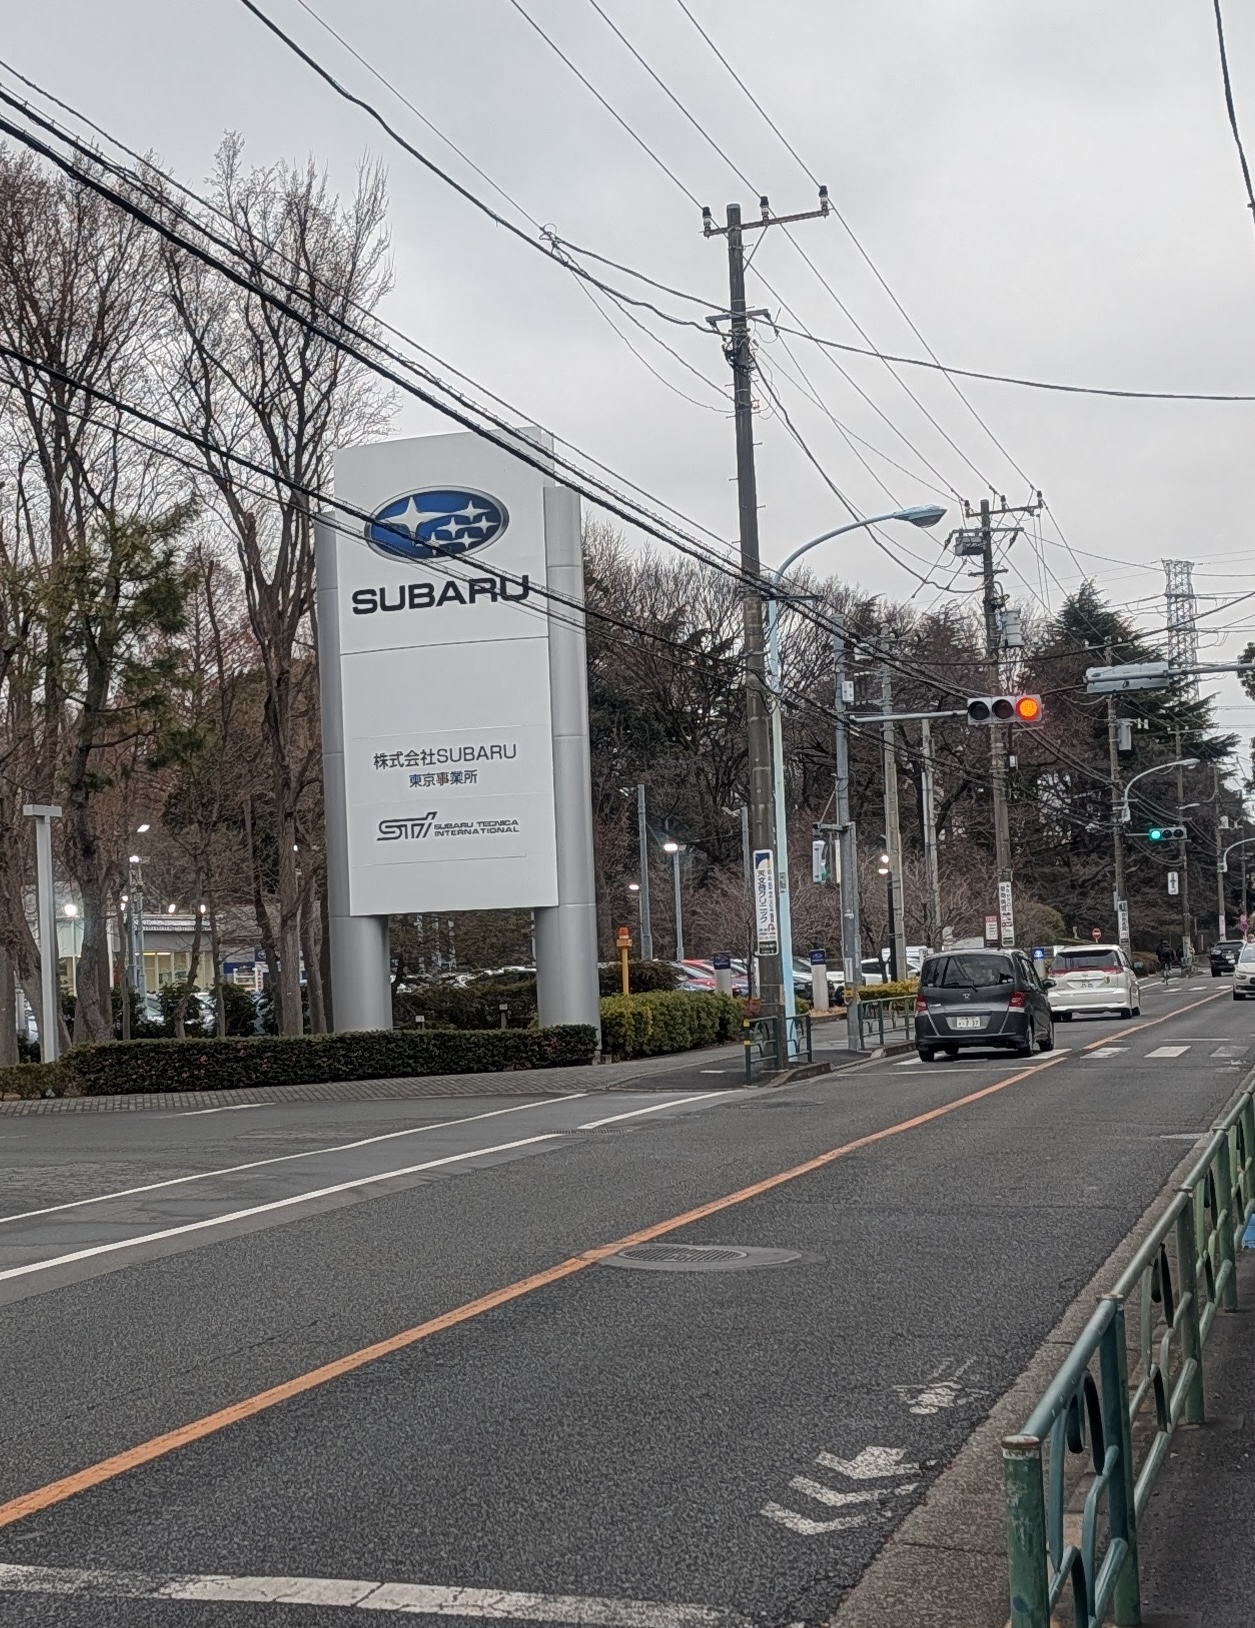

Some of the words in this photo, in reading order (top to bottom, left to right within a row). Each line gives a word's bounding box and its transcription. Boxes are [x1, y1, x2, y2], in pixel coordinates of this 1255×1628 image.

[352, 575, 529, 615] SUBARU
[373, 744, 517, 770] 株式会社SUBARU
[409, 769, 478, 788] 東京事業所
[434, 822, 474, 830] SUBARU
[476, 819, 520, 828] TECNICA
[434, 826, 520, 837] INTERNATIONAL
